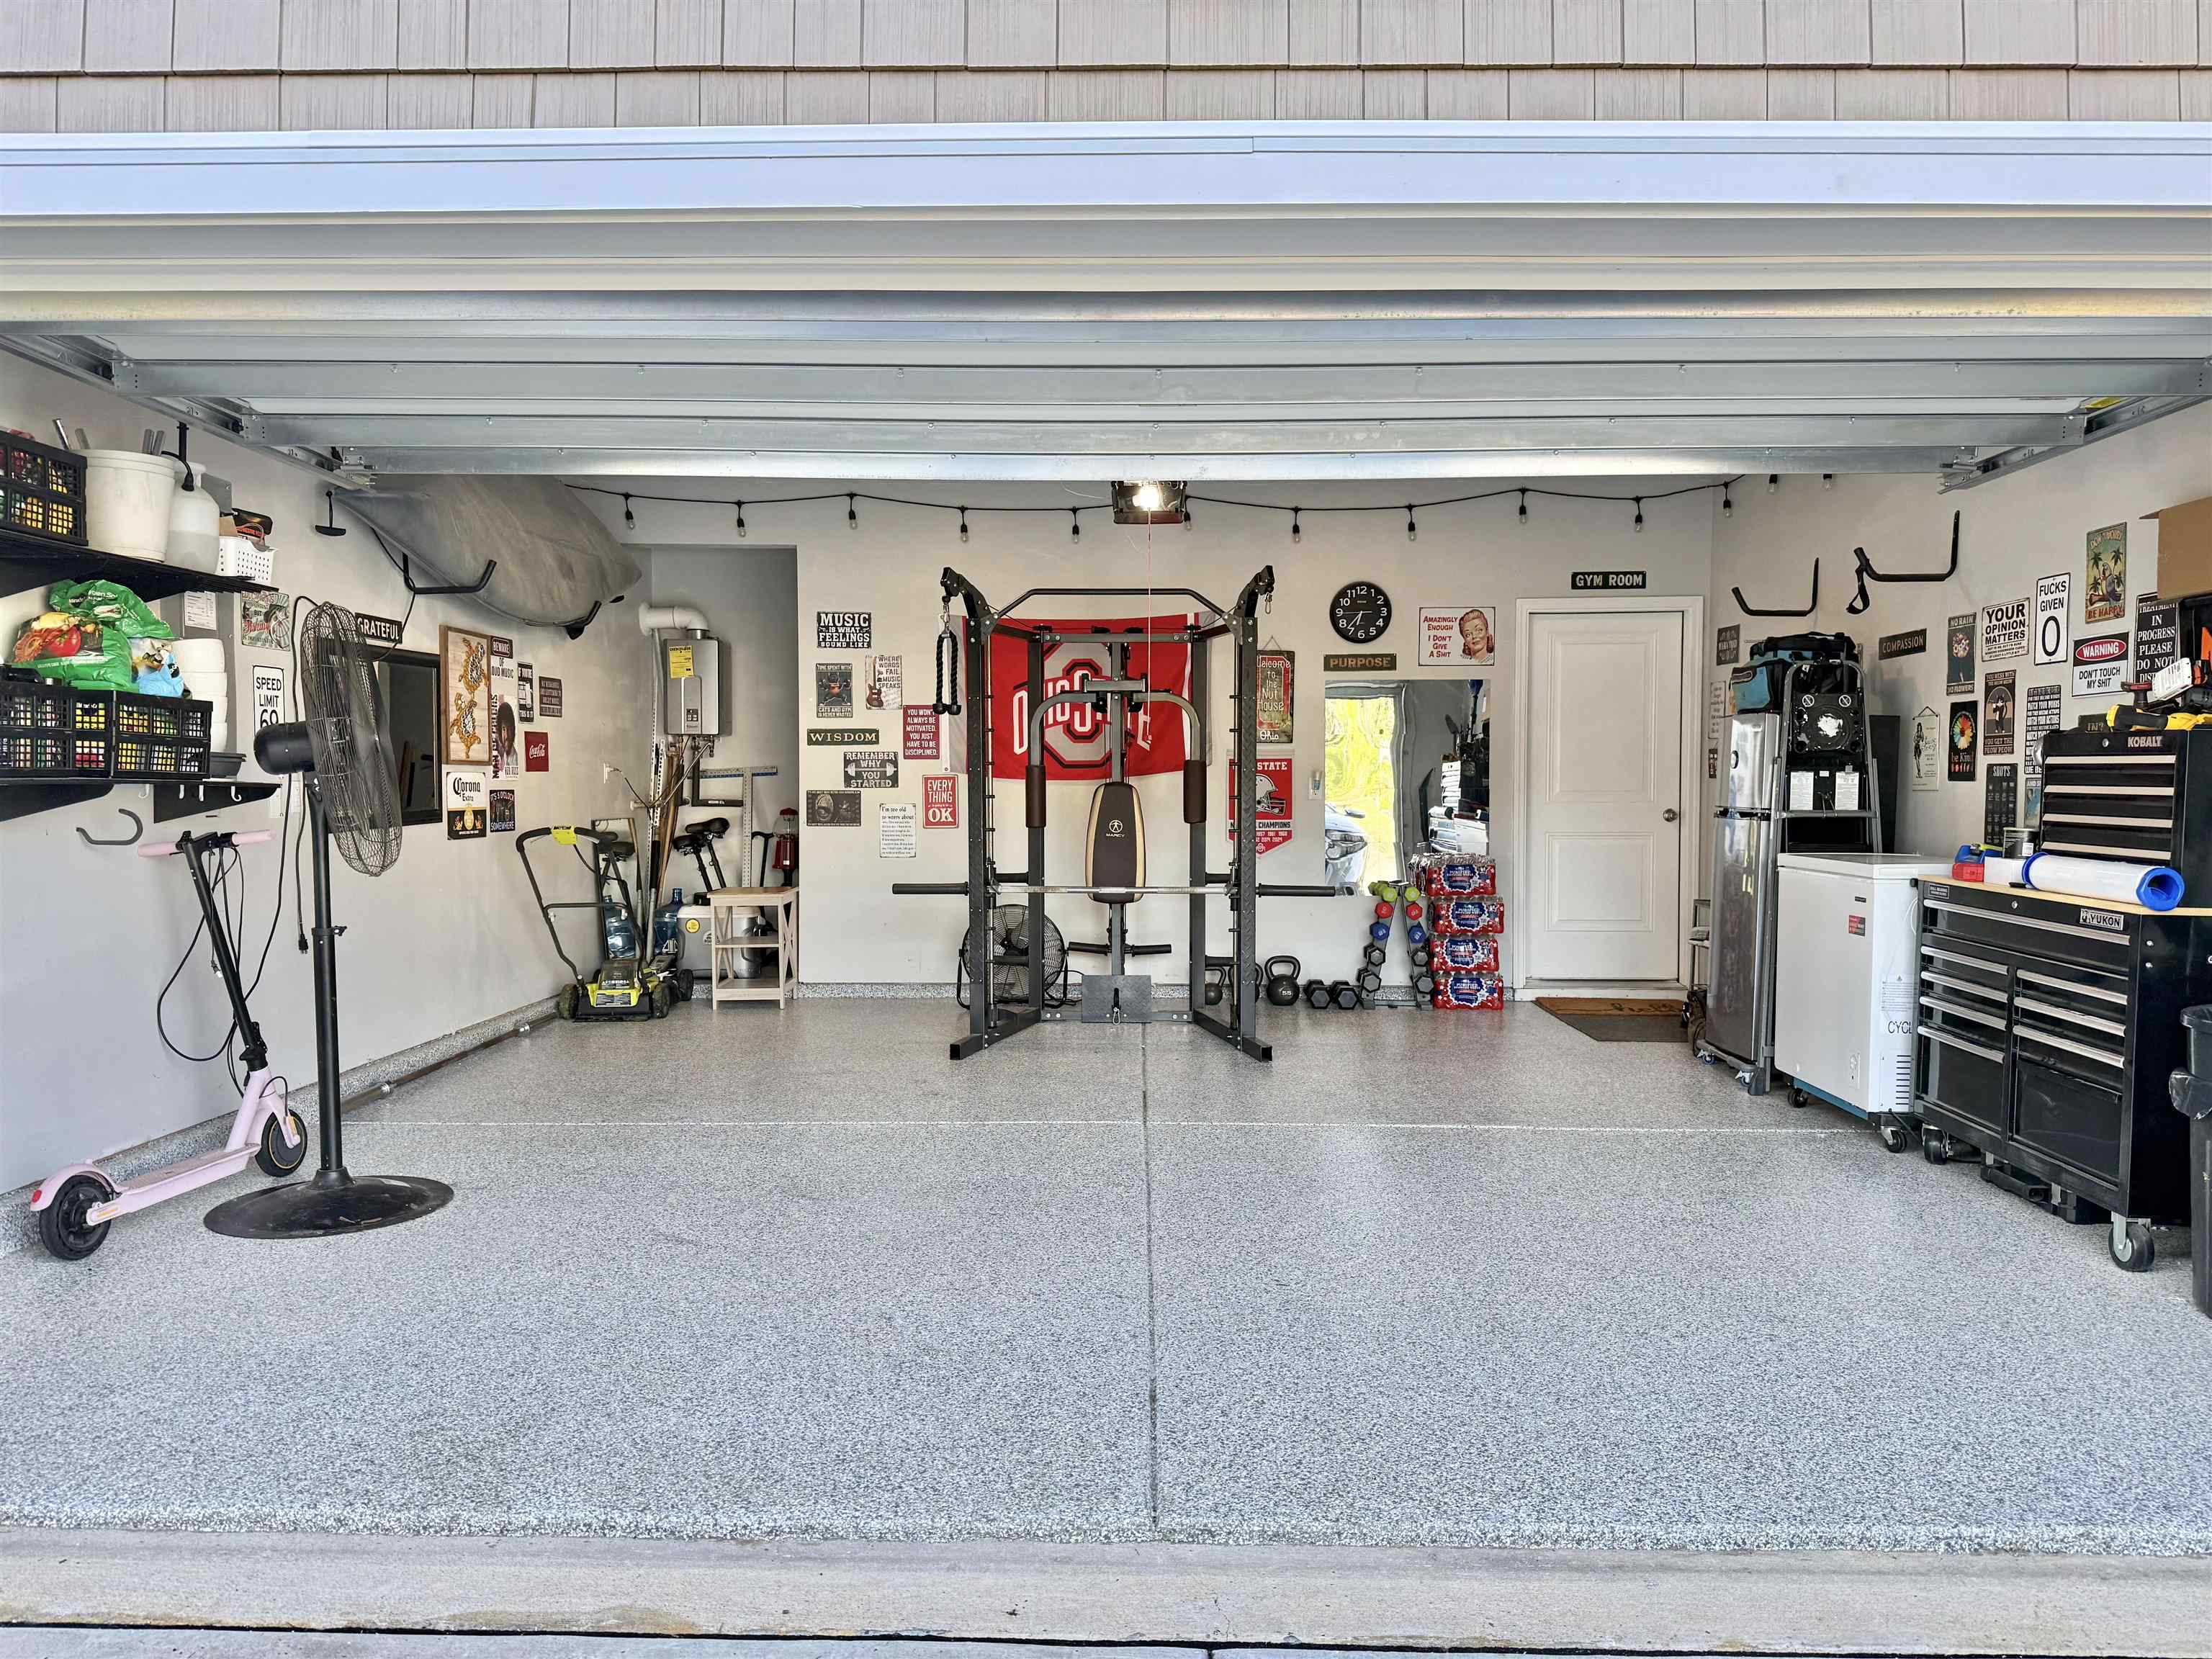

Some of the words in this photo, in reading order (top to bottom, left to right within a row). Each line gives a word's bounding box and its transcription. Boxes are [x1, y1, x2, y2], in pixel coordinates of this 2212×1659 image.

[1576, 575, 1603, 586] GYM
[1609, 575, 1642, 586] ROOM
[2039, 580, 2067, 596] FUCKS
[1339, 598, 1350, 606] 10
[2040, 597, 2064, 612] GIVEN
[1380, 608, 1388, 616] 3
[1987, 603, 2026, 624] YOUR
[820, 613, 869, 626] MUSIC
[1339, 619, 1346, 628] 8
[1959, 616, 1973, 625] RAIN
[2152, 614, 2163, 626] IN
[357, 618, 399, 640] GRATEFUL
[1985, 619, 2026, 634] OPINION
[819, 633, 870, 642] FEELINGS
[1357, 630, 1364, 639] 6
[1985, 630, 2025, 645] MATTERS
[2042, 616, 2060, 657] 0
[2138, 626, 2175, 642] PROGRESS
[493, 642, 510, 653] BEWARE
[1882, 635, 1924, 653] COMPASSION
[2082, 642, 2119, 657] WARNING
[2139, 642, 2173, 655] PLEASE
[1330, 657, 1391, 667] PURPOSE
[2136, 659, 2150, 670] DO
[2154, 657, 2175, 668] NOT
[491, 665, 500, 676] OUD
[501, 668, 514, 678] MUSIC
[2079, 668, 2098, 680] DON'T
[2099, 666, 2121, 678] TOUCH
[256, 677, 282, 691] SPEED
[1267, 680, 1277, 688] the
[2087, 680, 2097, 689] MY
[2098, 678, 2112, 688] SHIT
[1262, 688, 1277, 699] Nut
[258, 695, 279, 709] LIMIT
[1257, 699, 1285, 711] House
[1013, 679, 1070, 755] OIO
[809, 733, 877, 742] WISDOM
[1259, 730, 1279, 740] Ohio
[2127, 736, 2163, 748] KOBALT
[846, 752, 895, 760] REMEMBER
[1993, 765, 2010, 777] SHOTS
[453, 777, 481, 797] Corona
[927, 780, 953, 791] EVERY
[928, 791, 953, 803] THING
[927, 807, 954, 822] OK
[490, 822, 514, 831] SOMEWHERE
[2090, 914, 2121, 927] YUKON
